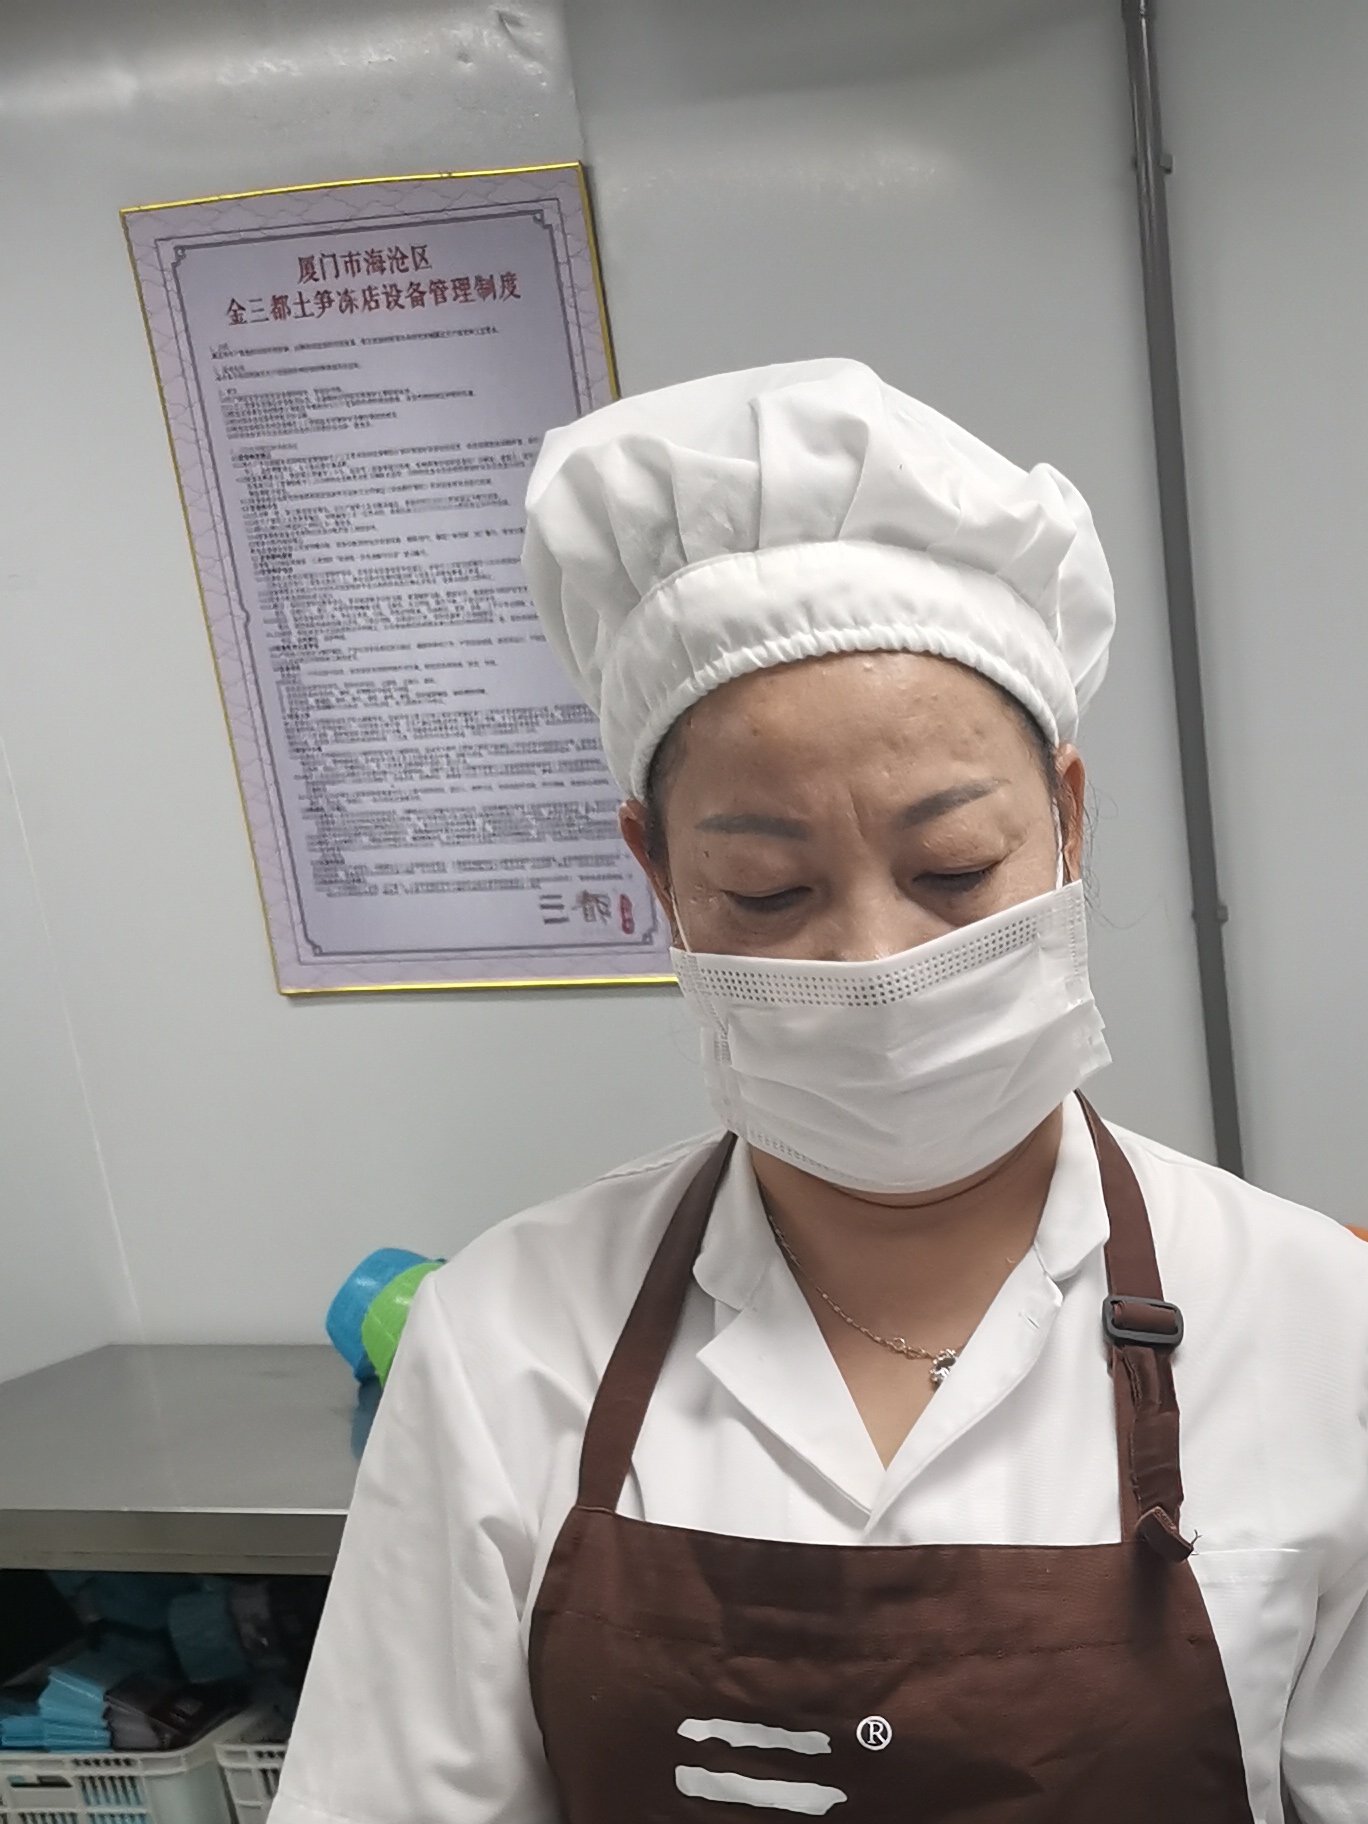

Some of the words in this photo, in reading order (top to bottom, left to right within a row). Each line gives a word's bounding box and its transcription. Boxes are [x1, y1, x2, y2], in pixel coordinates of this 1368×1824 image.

[297, 244, 433, 286] 厦门市海沧区
[226, 270, 523, 327] 金三都土笋冻店设备管理制度
